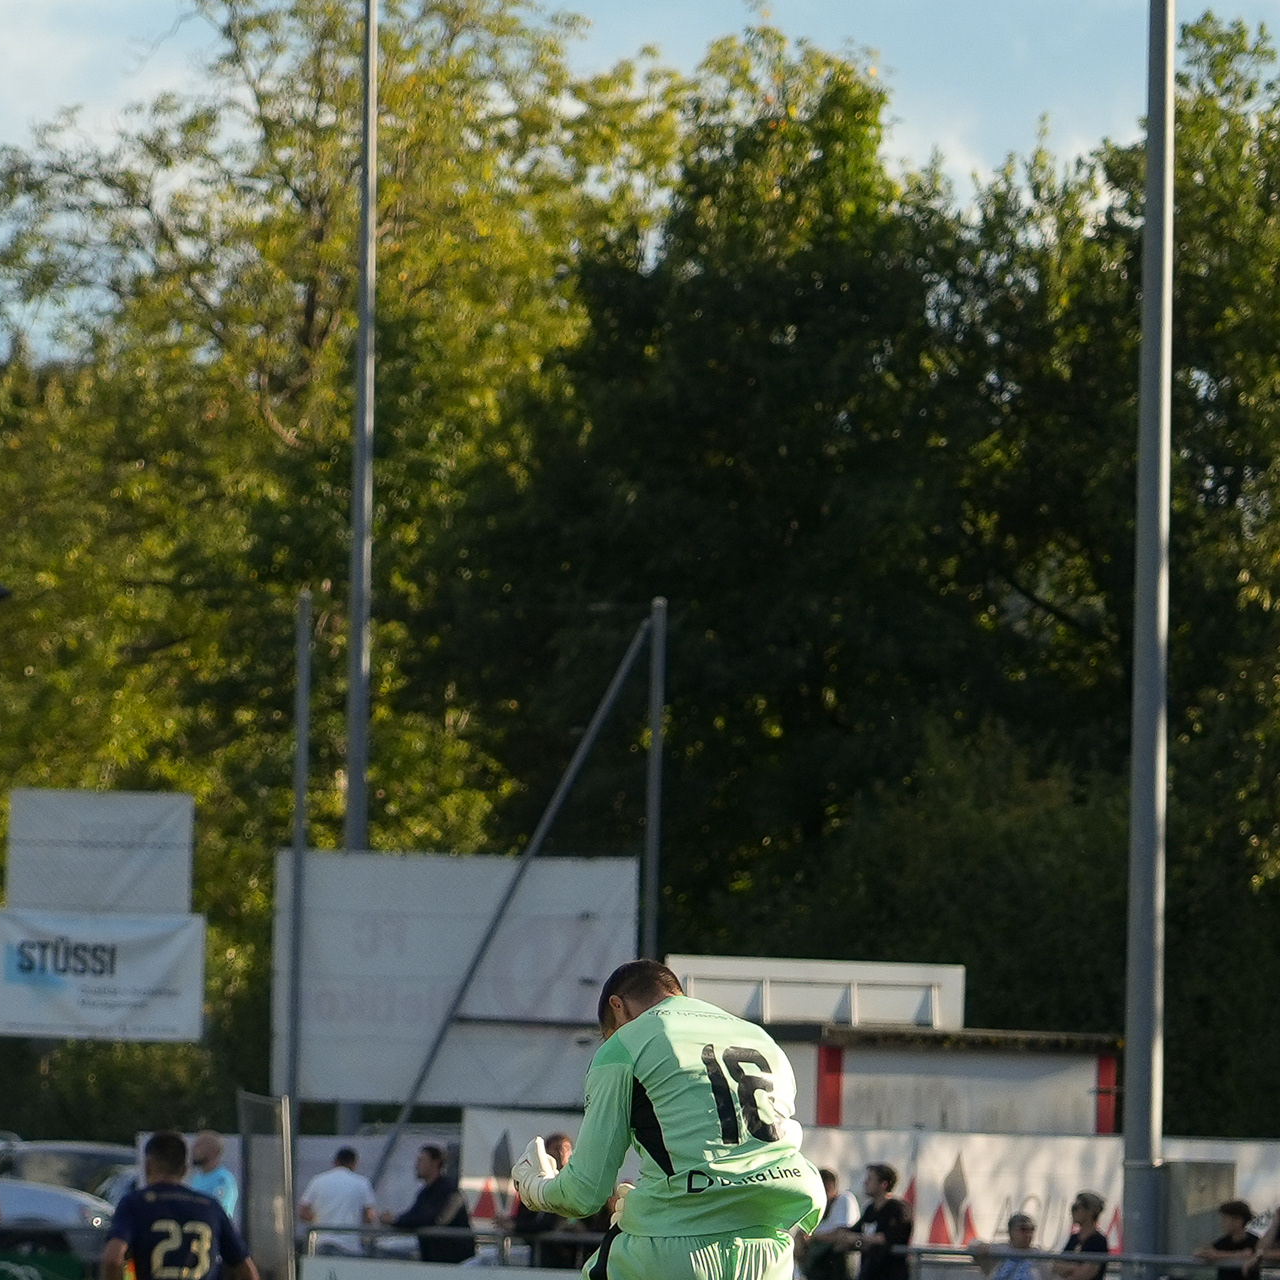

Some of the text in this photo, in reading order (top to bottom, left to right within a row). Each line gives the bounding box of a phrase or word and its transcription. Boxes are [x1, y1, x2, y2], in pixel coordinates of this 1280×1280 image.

[17, 936, 117, 977] STÜSSI
[701, 1044, 786, 1144] 16
[768, 1166, 802, 1180] Line
[150, 1219, 213, 1280] 23
